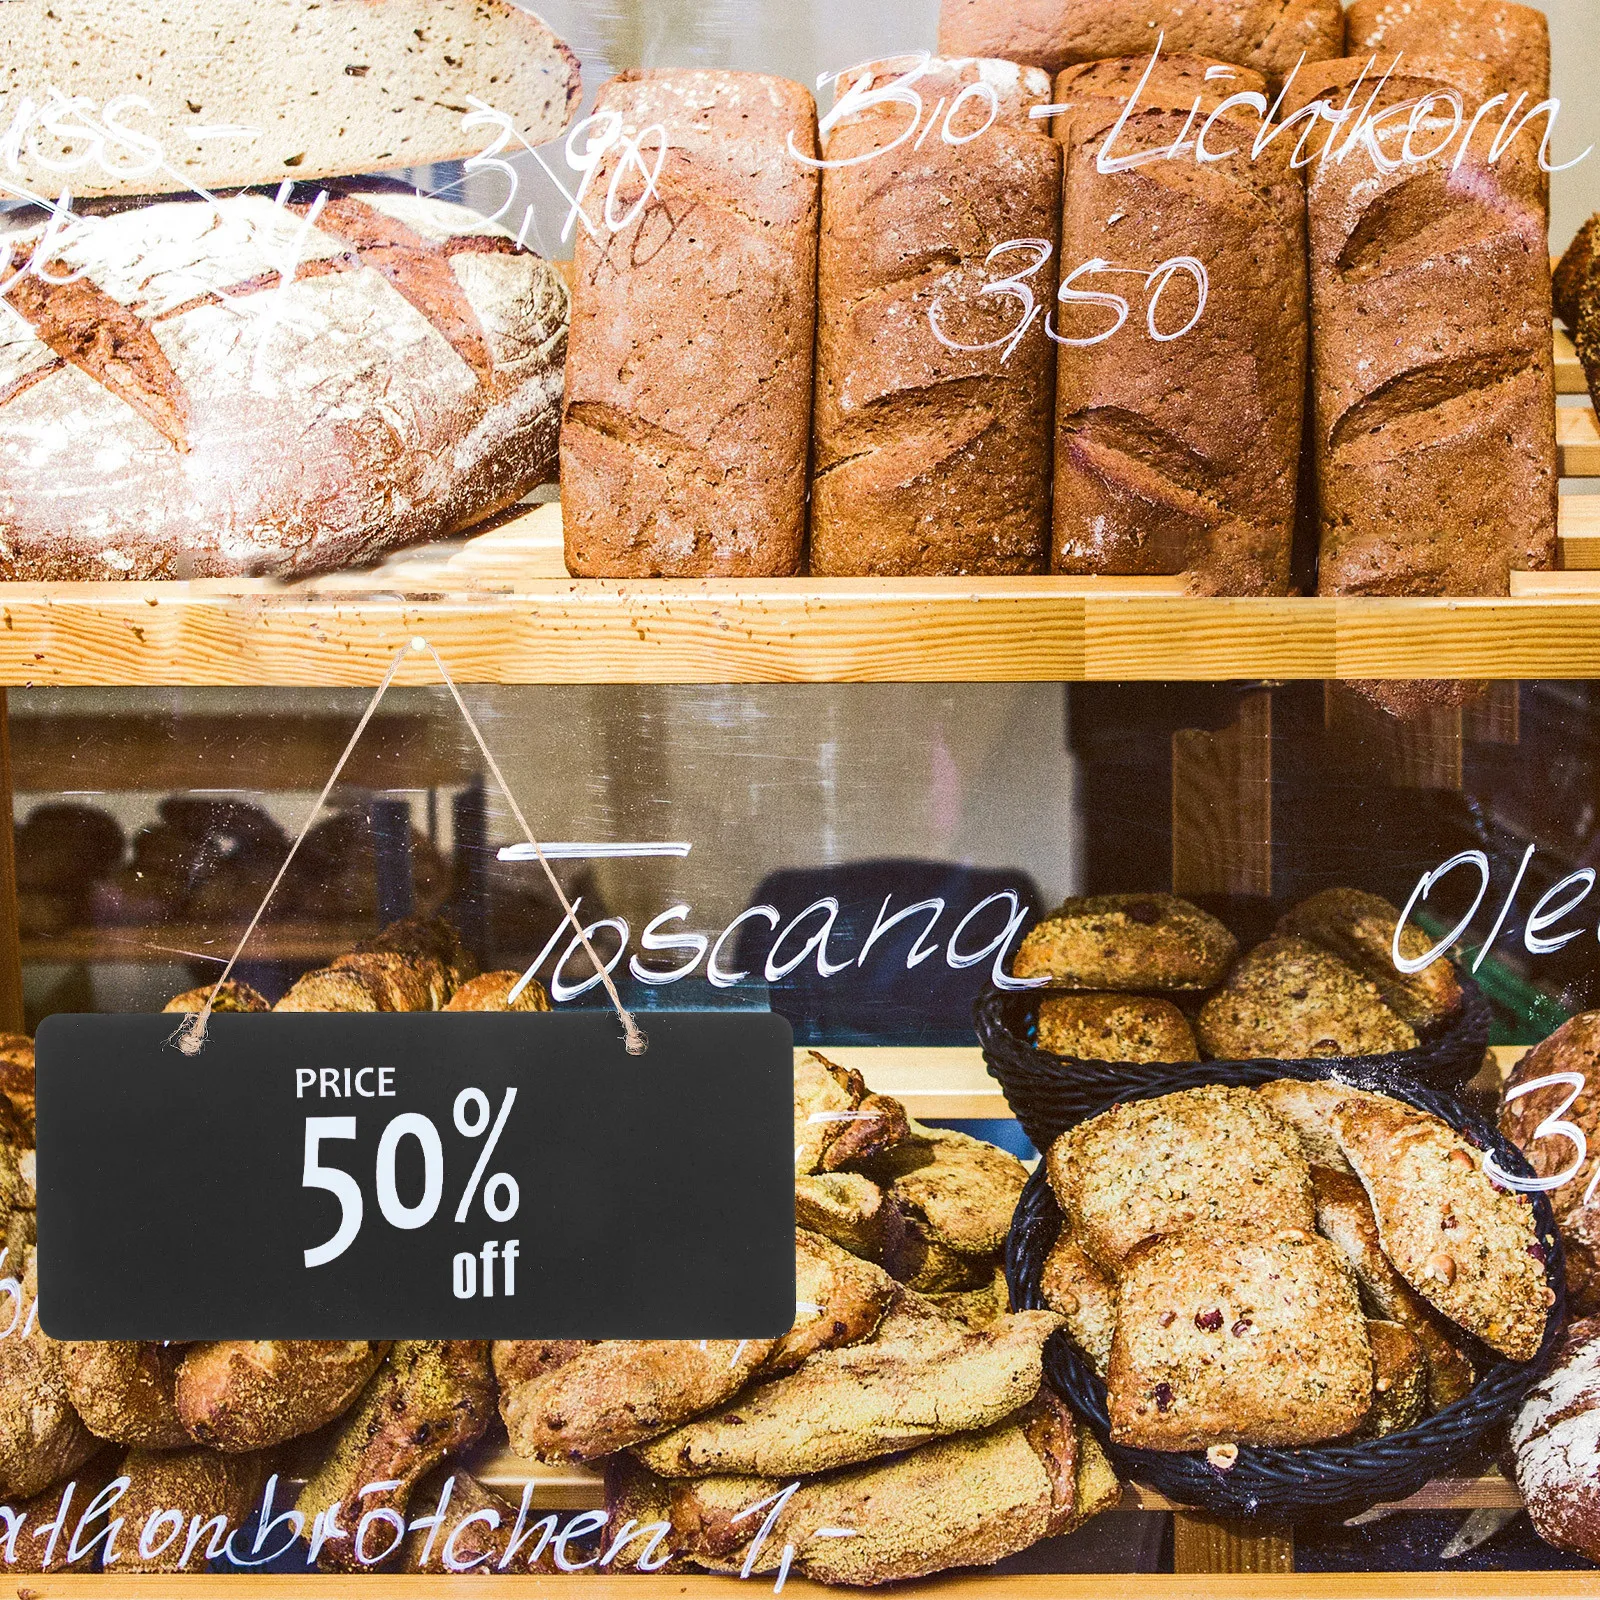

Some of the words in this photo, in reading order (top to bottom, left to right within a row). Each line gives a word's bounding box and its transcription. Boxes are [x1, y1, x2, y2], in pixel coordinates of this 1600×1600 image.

[786, 48, 999, 168] Bio
[1096, 30, 1595, 174] Lichtkorn
[928, 238, 1210, 365] 3,50
[496, 842, 1053, 1005] Toscana
[1392, 843, 1600, 974] Ole
[296, 1067, 397, 1098] PRICE
[302, 1086, 520, 1269] 50%
[453, 1239, 520, 1300] off
